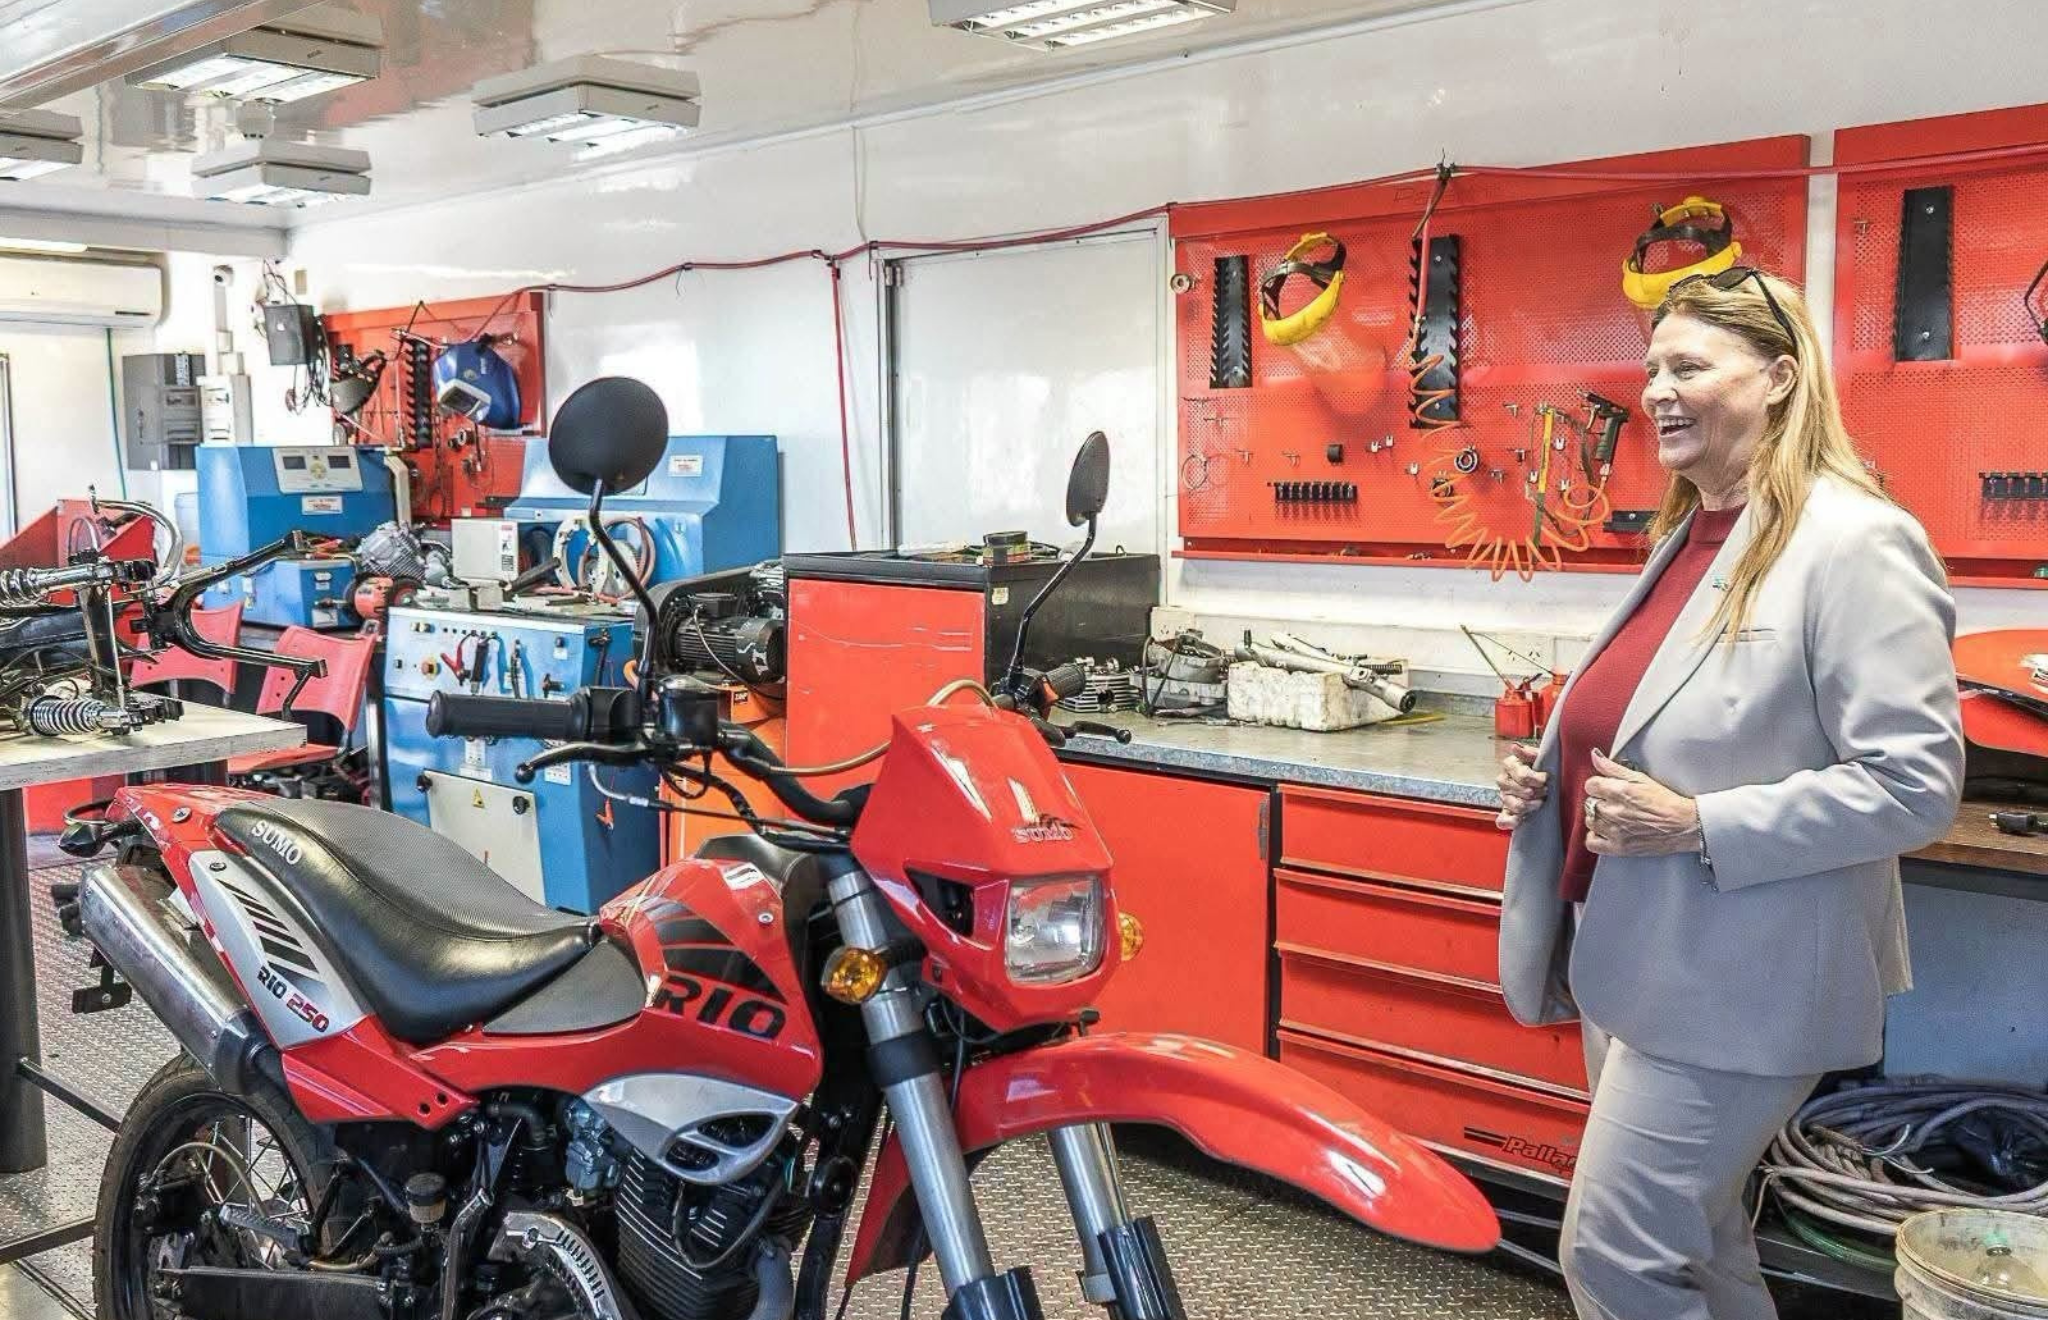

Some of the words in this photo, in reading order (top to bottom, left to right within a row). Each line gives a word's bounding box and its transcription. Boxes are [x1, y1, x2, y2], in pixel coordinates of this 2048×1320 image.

[251, 820, 303, 865] SUMO
[256, 966, 288, 1000] RIO
[286, 993, 330, 1033] 250
[652, 975, 786, 1040] RIO
